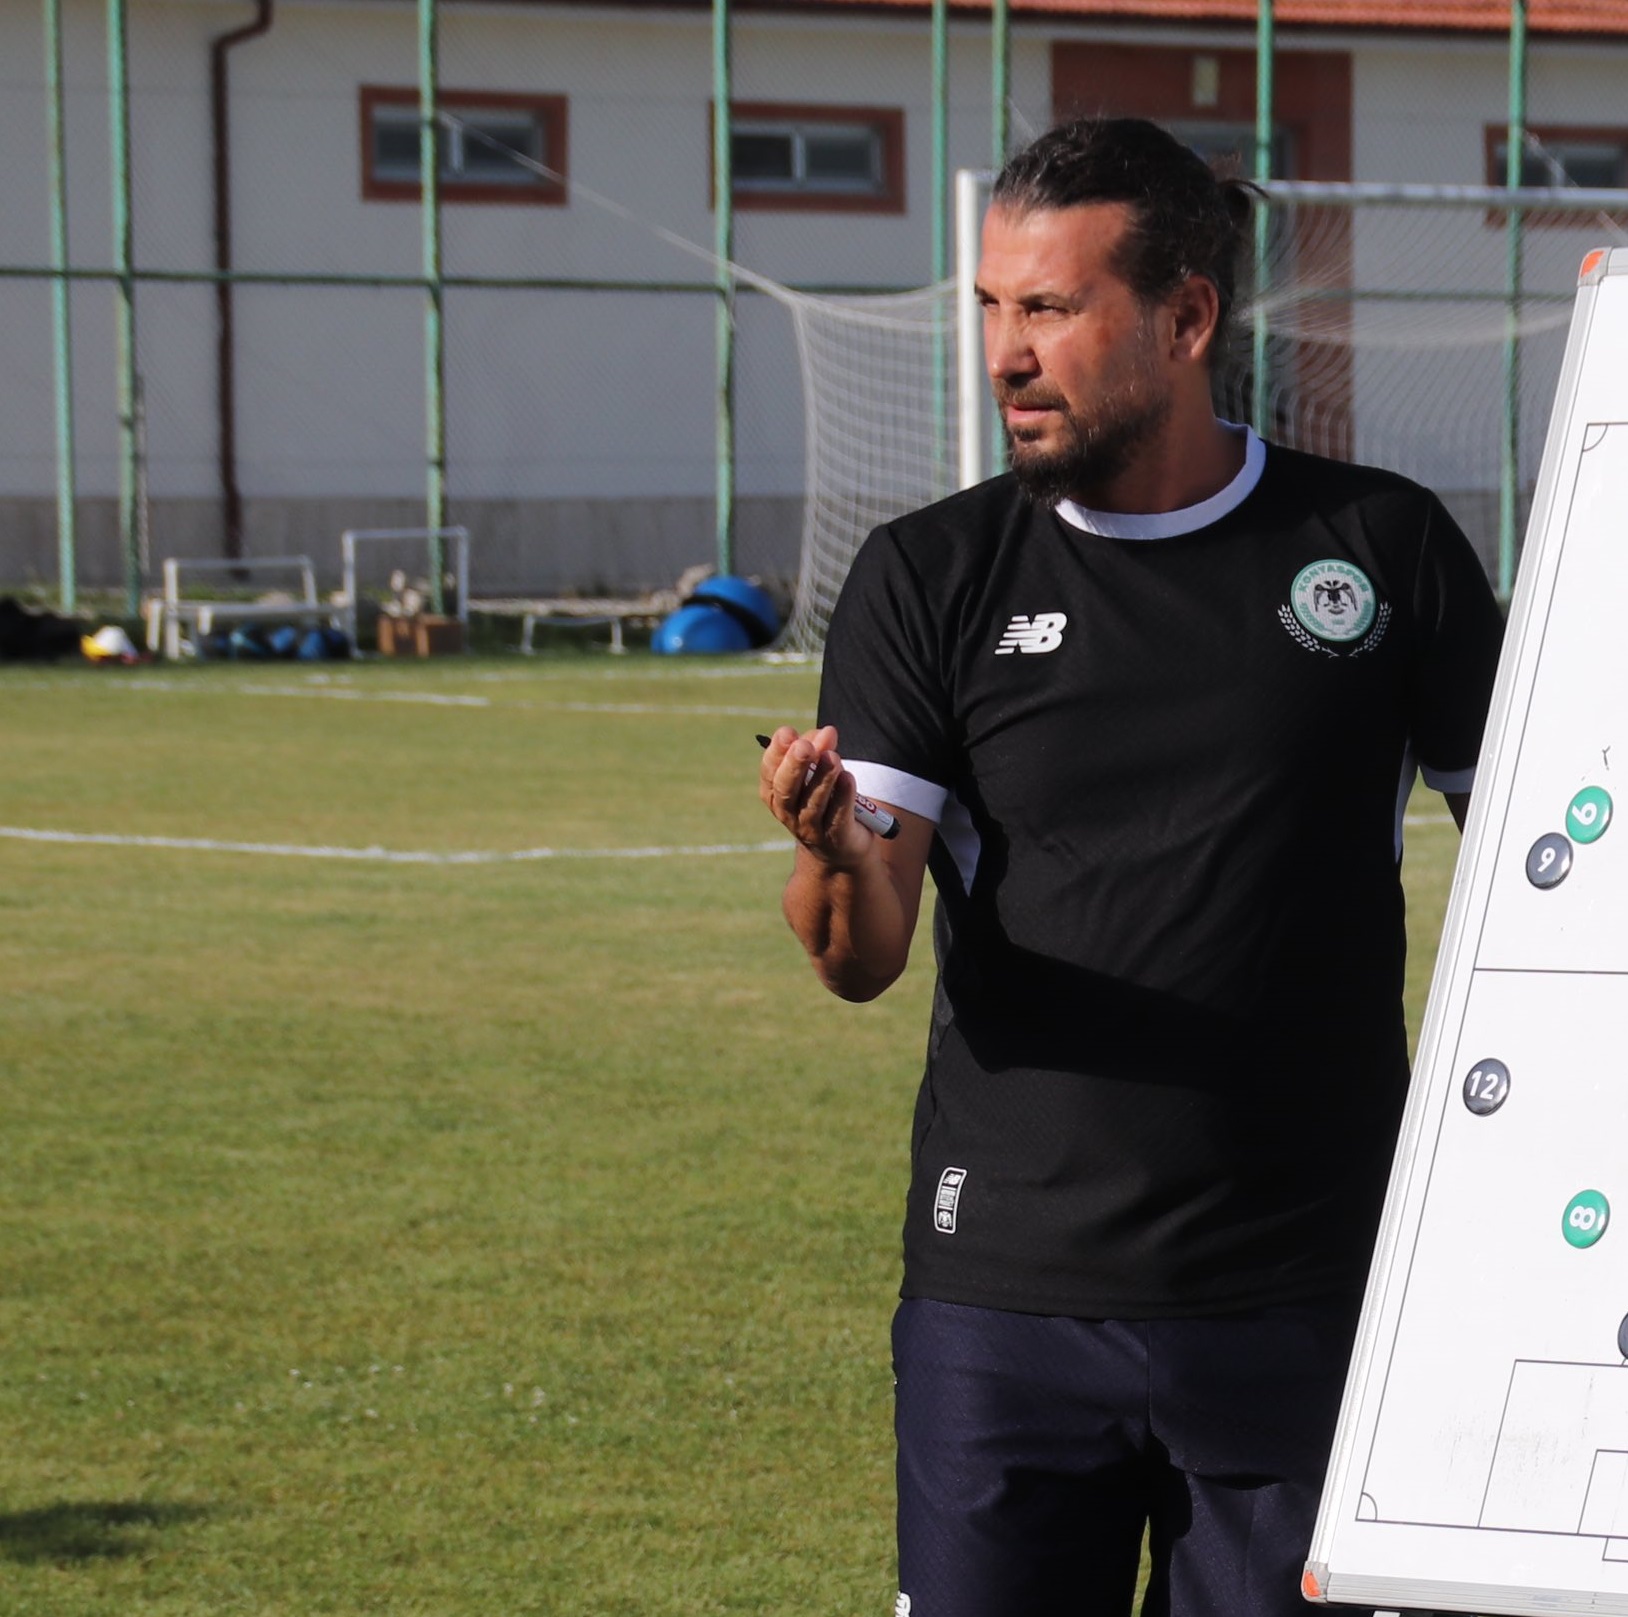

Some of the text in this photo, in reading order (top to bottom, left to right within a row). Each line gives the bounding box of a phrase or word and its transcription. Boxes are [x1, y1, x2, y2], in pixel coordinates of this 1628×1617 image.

[1297, 564, 1371, 594] KONYASPOR
[1470, 1071, 1498, 1100] 12
[1569, 1206, 1597, 1231] 8
